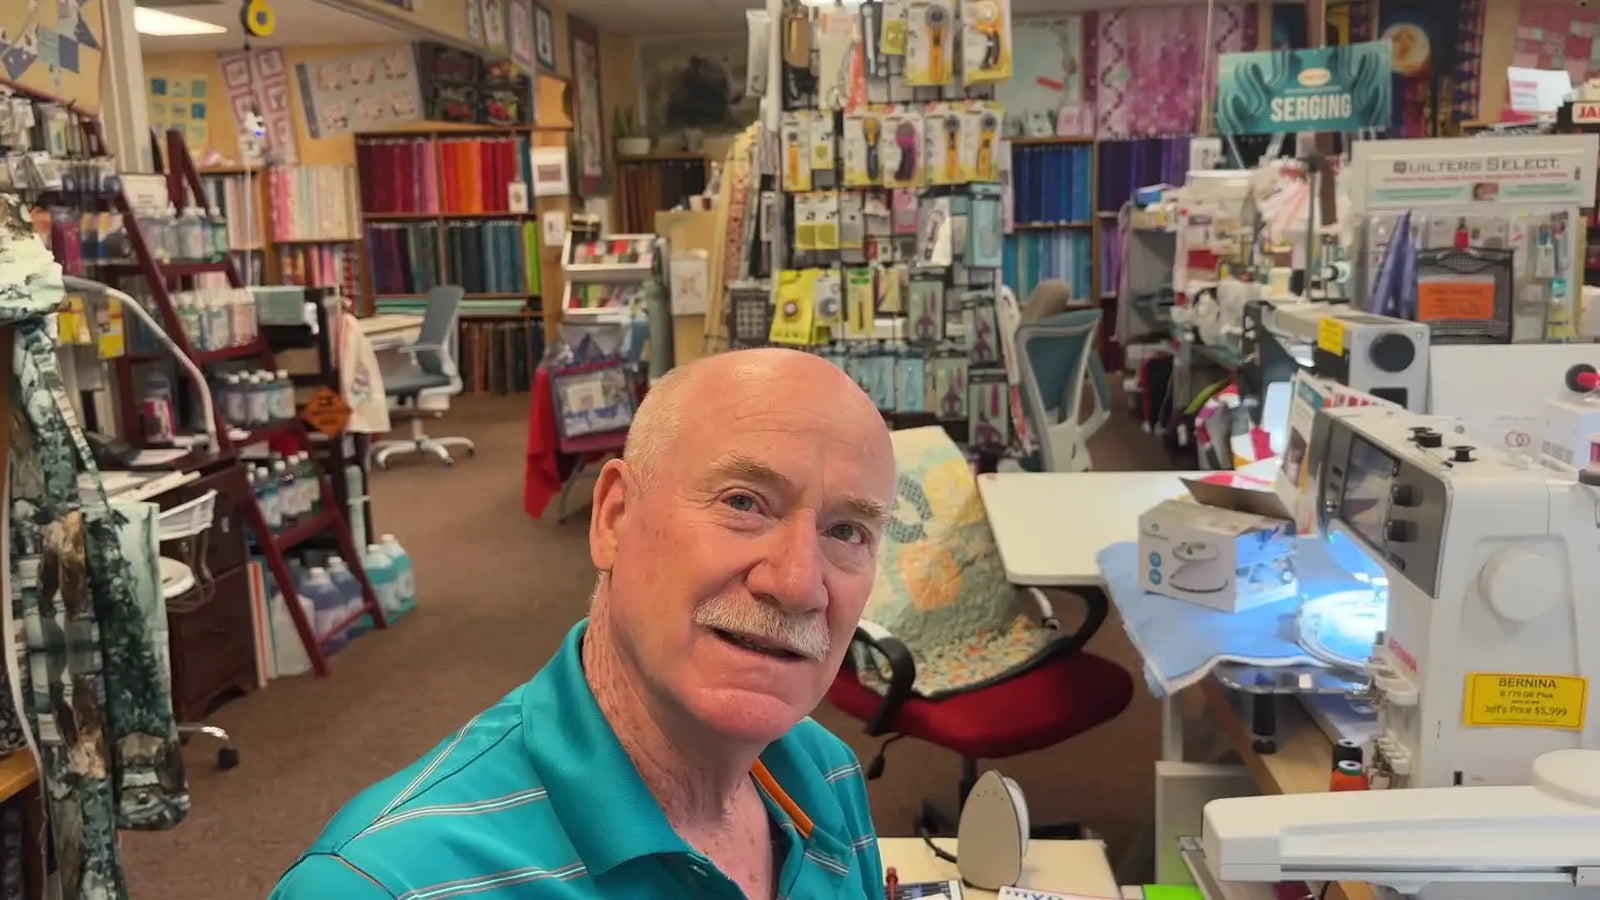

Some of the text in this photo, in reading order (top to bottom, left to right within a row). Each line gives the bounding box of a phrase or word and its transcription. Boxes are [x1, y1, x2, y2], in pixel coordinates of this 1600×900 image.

[1271, 93, 1353, 122] SERGING
[1499, 677, 1557, 689] BERNINA
[1485, 705, 1567, 717] Jeff's Price $5,999
